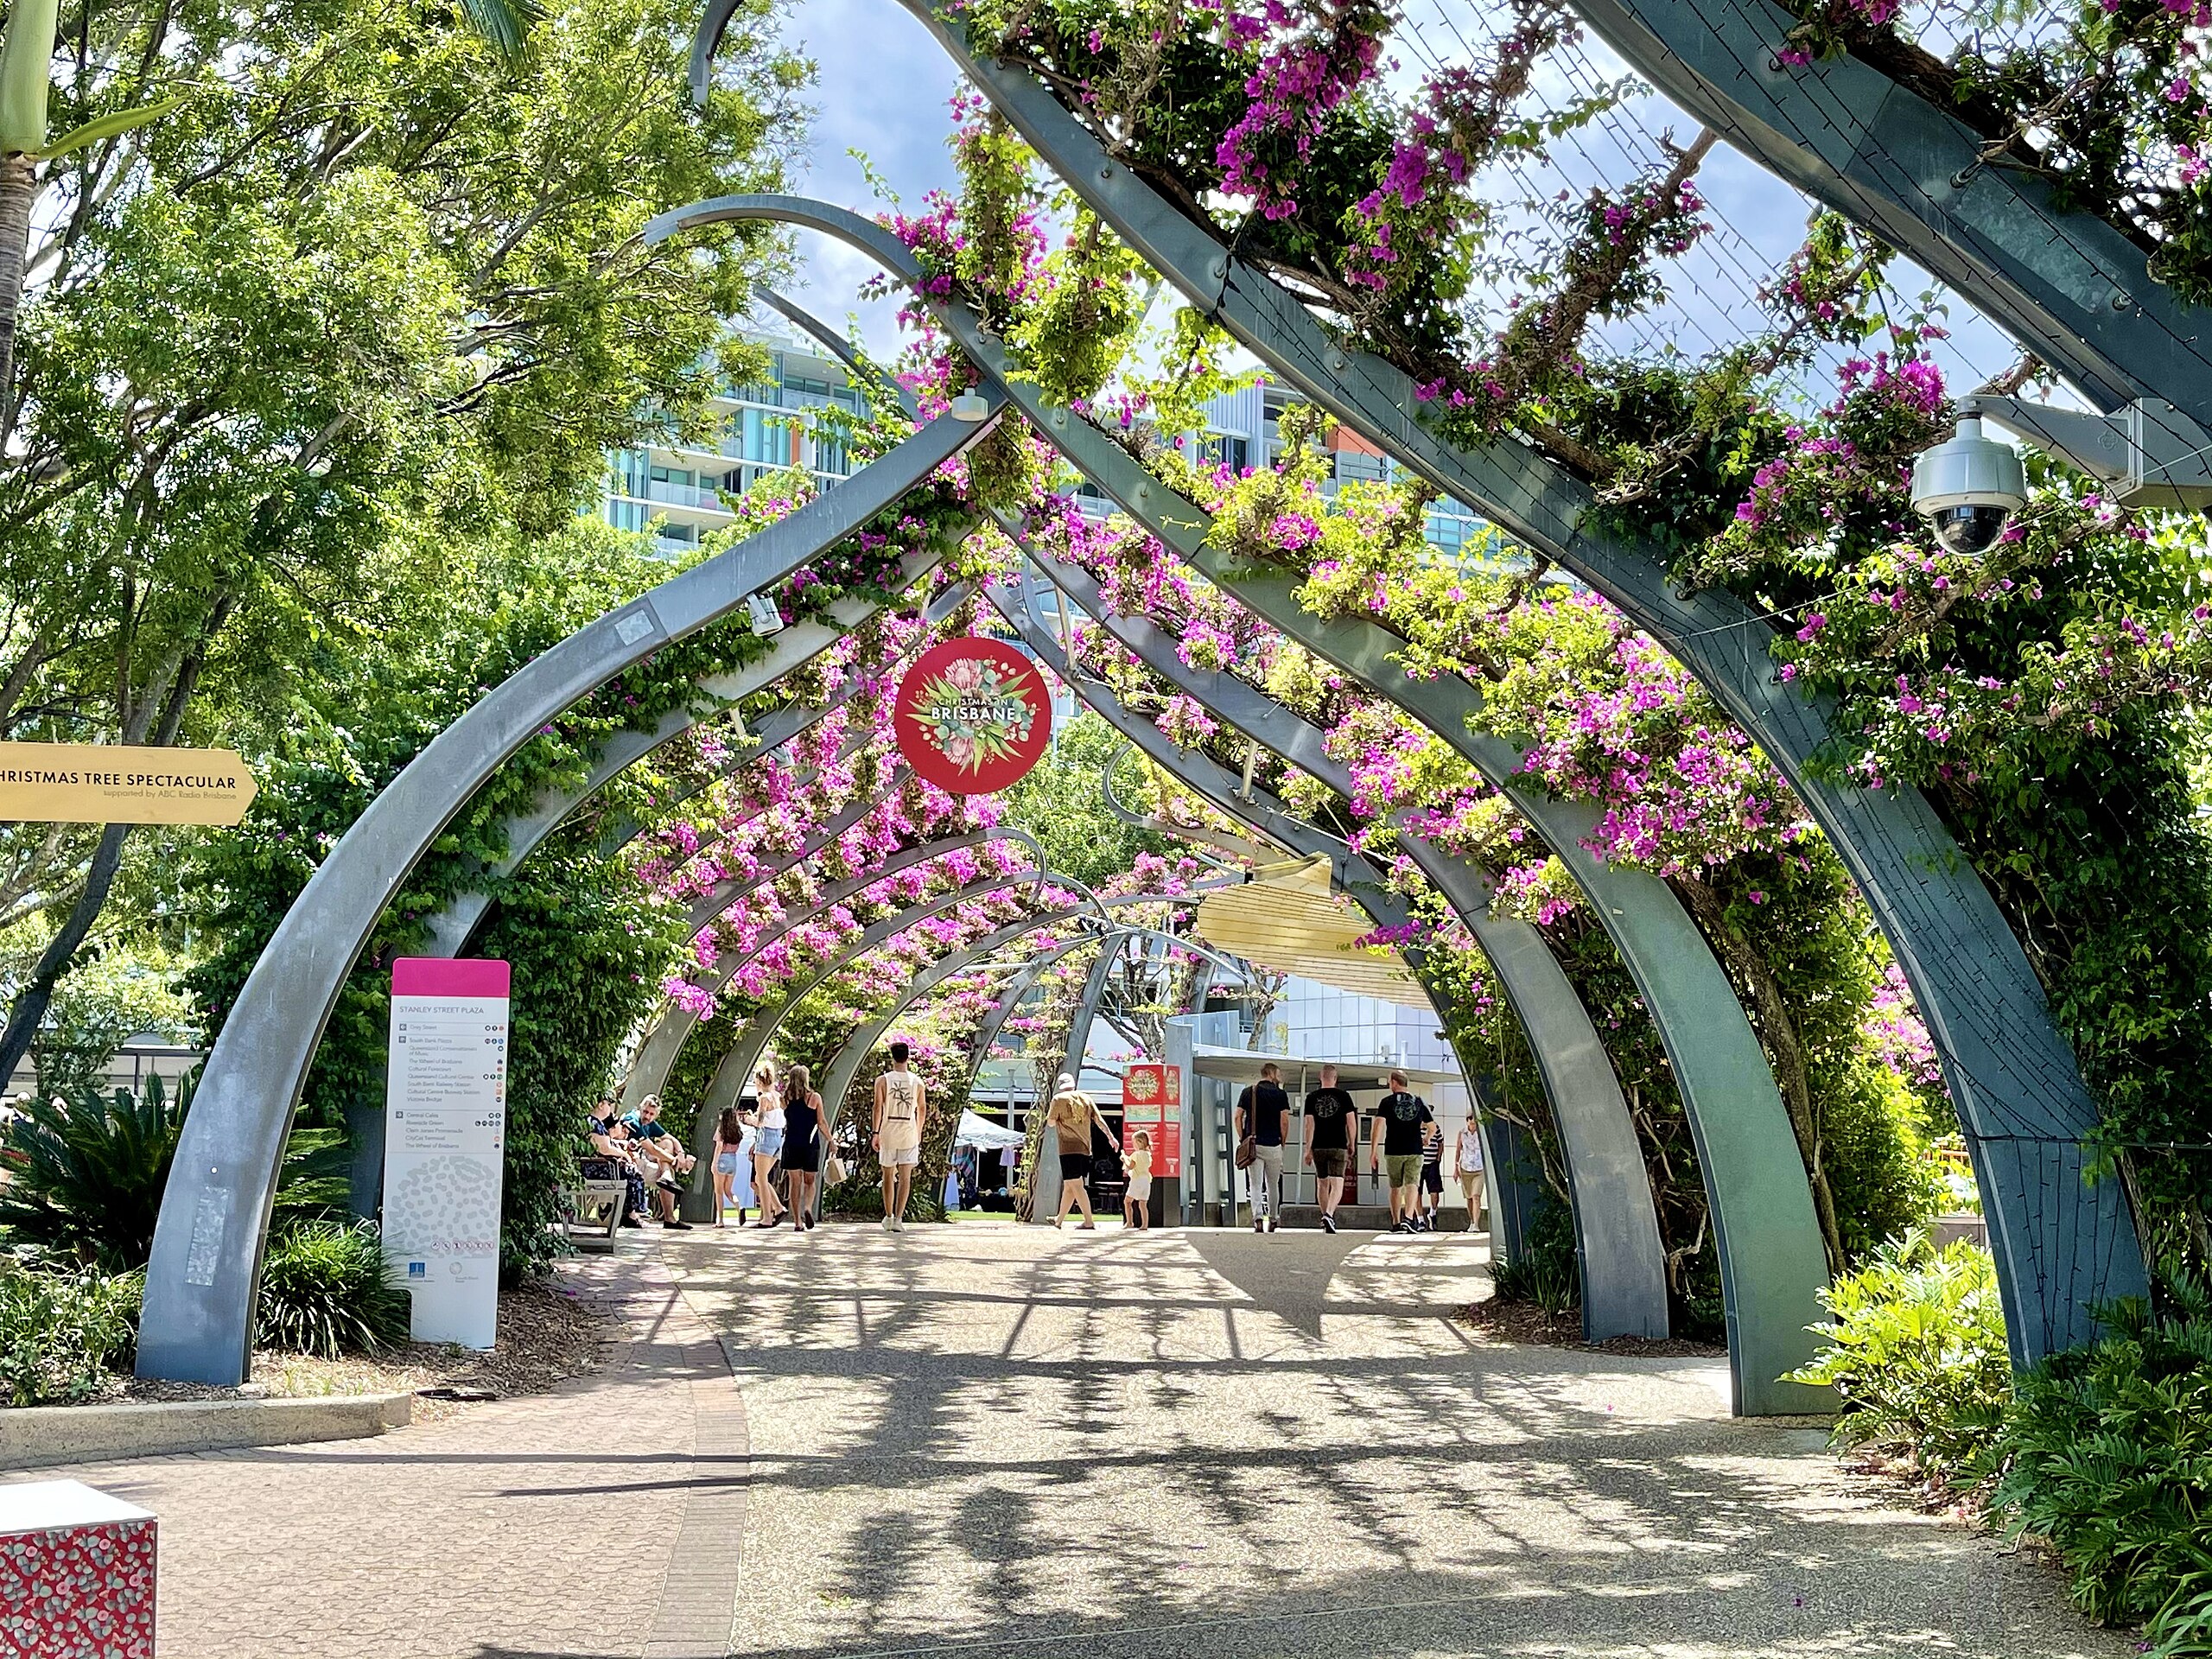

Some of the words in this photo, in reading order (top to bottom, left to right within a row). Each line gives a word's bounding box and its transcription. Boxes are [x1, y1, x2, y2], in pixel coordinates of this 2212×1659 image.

[938, 697, 992, 706] CHRISTMAS
[931, 707, 1015, 721] BRISBANE
[84, 772, 121, 785] TREE
[126, 773, 236, 789] SPECTACULAR
[103, 789, 143, 798] supported
[145, 789, 156, 799] by
[157, 790, 175, 798] ABC
[179, 790, 200, 798] Radio
[203, 791, 237, 800] Brisbane
